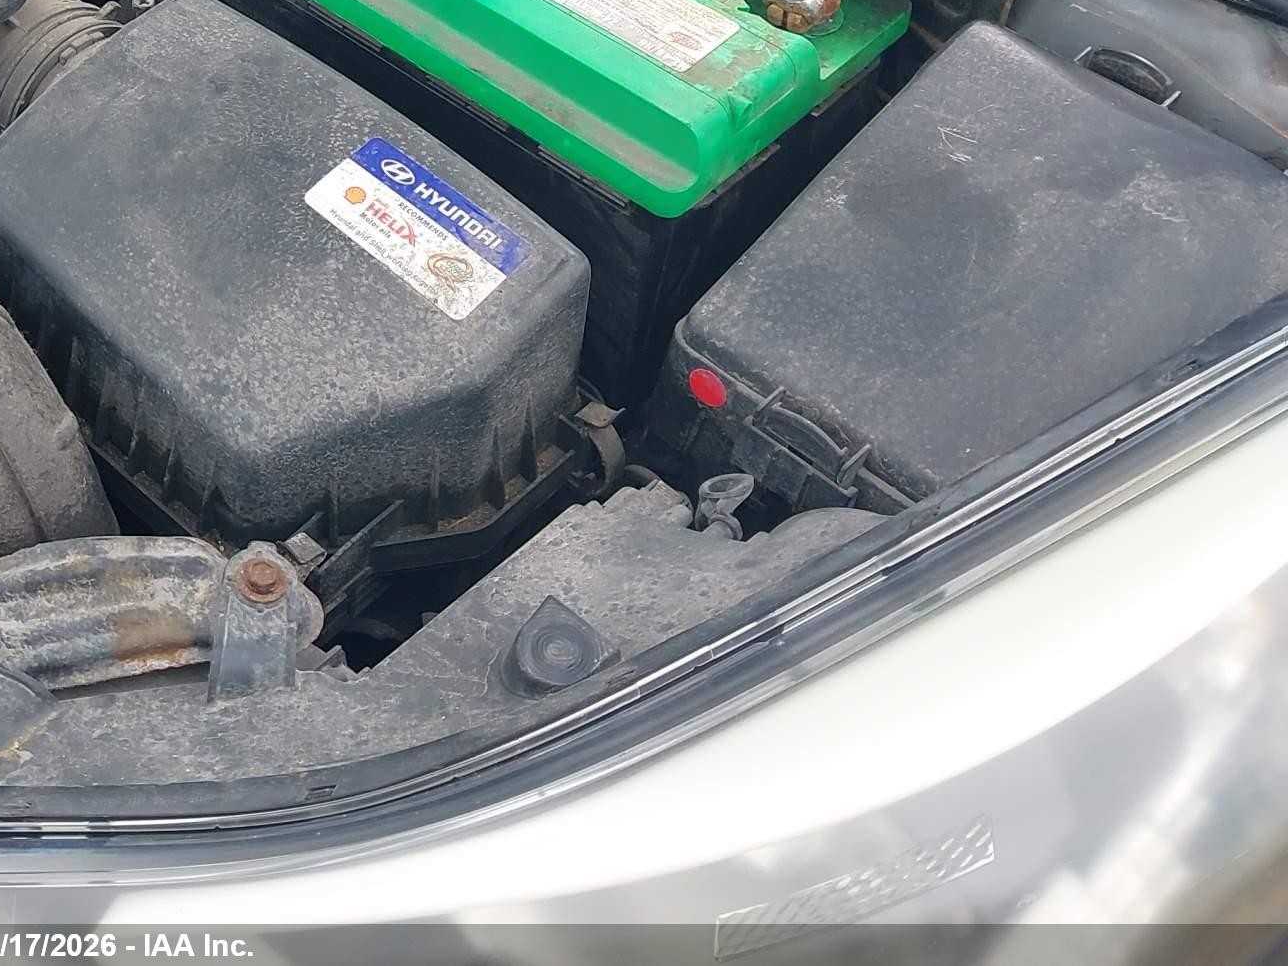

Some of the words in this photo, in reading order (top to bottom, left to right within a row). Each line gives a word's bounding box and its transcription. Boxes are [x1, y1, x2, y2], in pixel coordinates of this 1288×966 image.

[329, 208, 358, 232] Hyundai
[365, 202, 418, 247] HELIX
[398, 202, 448, 241] RECOMMENDS
[414, 183, 504, 251] HYUNDAI
